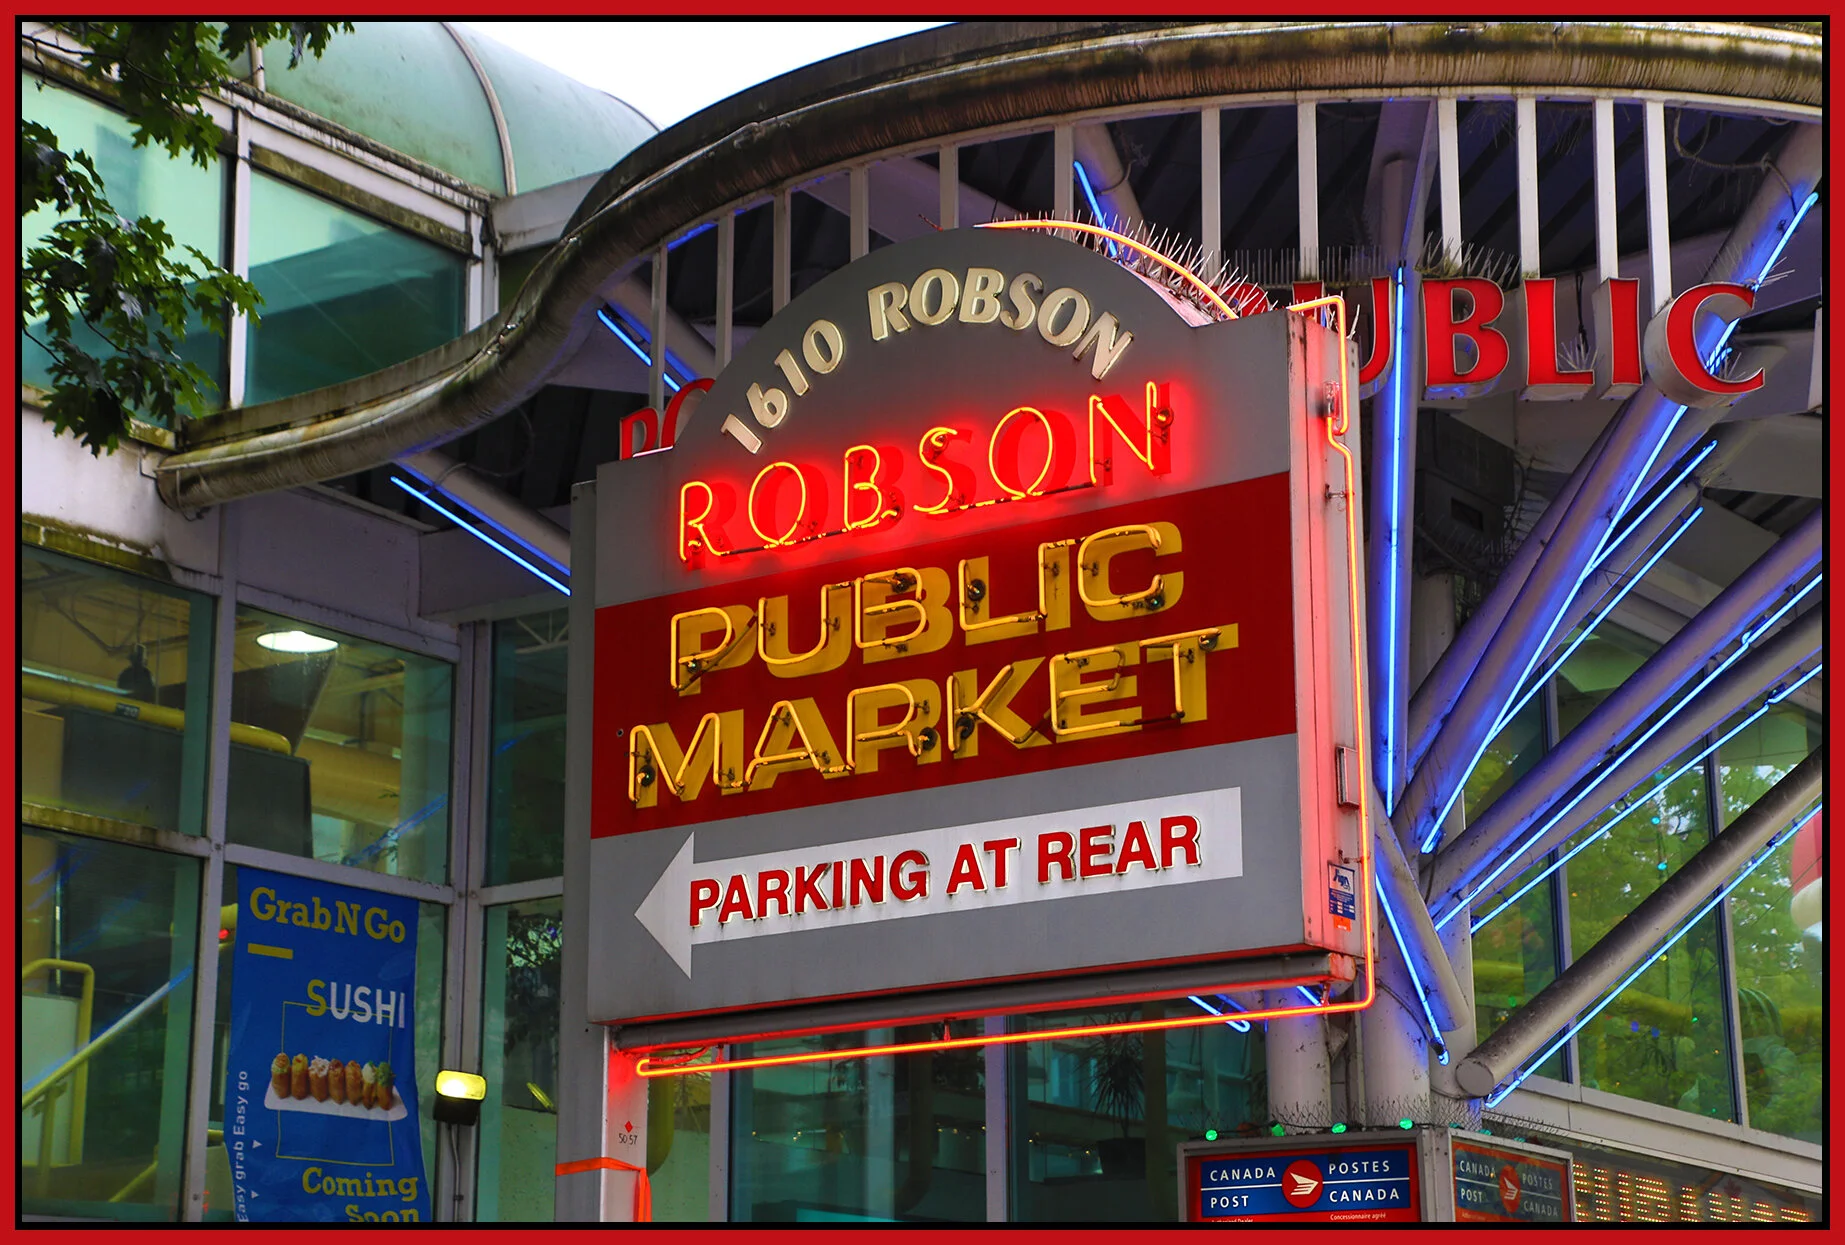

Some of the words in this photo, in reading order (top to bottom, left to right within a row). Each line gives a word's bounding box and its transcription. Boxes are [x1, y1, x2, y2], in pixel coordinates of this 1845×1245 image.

[720, 319, 844, 455] 1610
[867, 267, 1134, 381] ROBSON
[679, 381, 1173, 570] ROBSON
[670, 521, 1184, 696] PUBLIC
[629, 624, 1239, 809] MARKET
[689, 850, 930, 927] PARKING
[946, 837, 1020, 895] AT
[1036, 814, 1202, 884] REAR
[250, 886, 332, 931] Grab
[334, 900, 361, 936] N
[364, 907, 406, 943] Go
[306, 979, 405, 1029] SUSHI
[238, 1070, 249, 1091] go
[233, 1095, 249, 1136] Easy
[233, 1140, 247, 1180] grab
[1210, 1166, 1276, 1182] CANADA
[1328, 1160, 1390, 1175] POSTES
[1459, 1159, 1497, 1178] CANADA
[302, 1166, 419, 1202] Coming
[1329, 1187, 1400, 1203] CANADA
[1460, 1187, 1483, 1203] POST
[1522, 1172, 1553, 1190] POSTES
[1210, 1195, 1249, 1209] POST
[1523, 1200, 1558, 1217] CANADA
